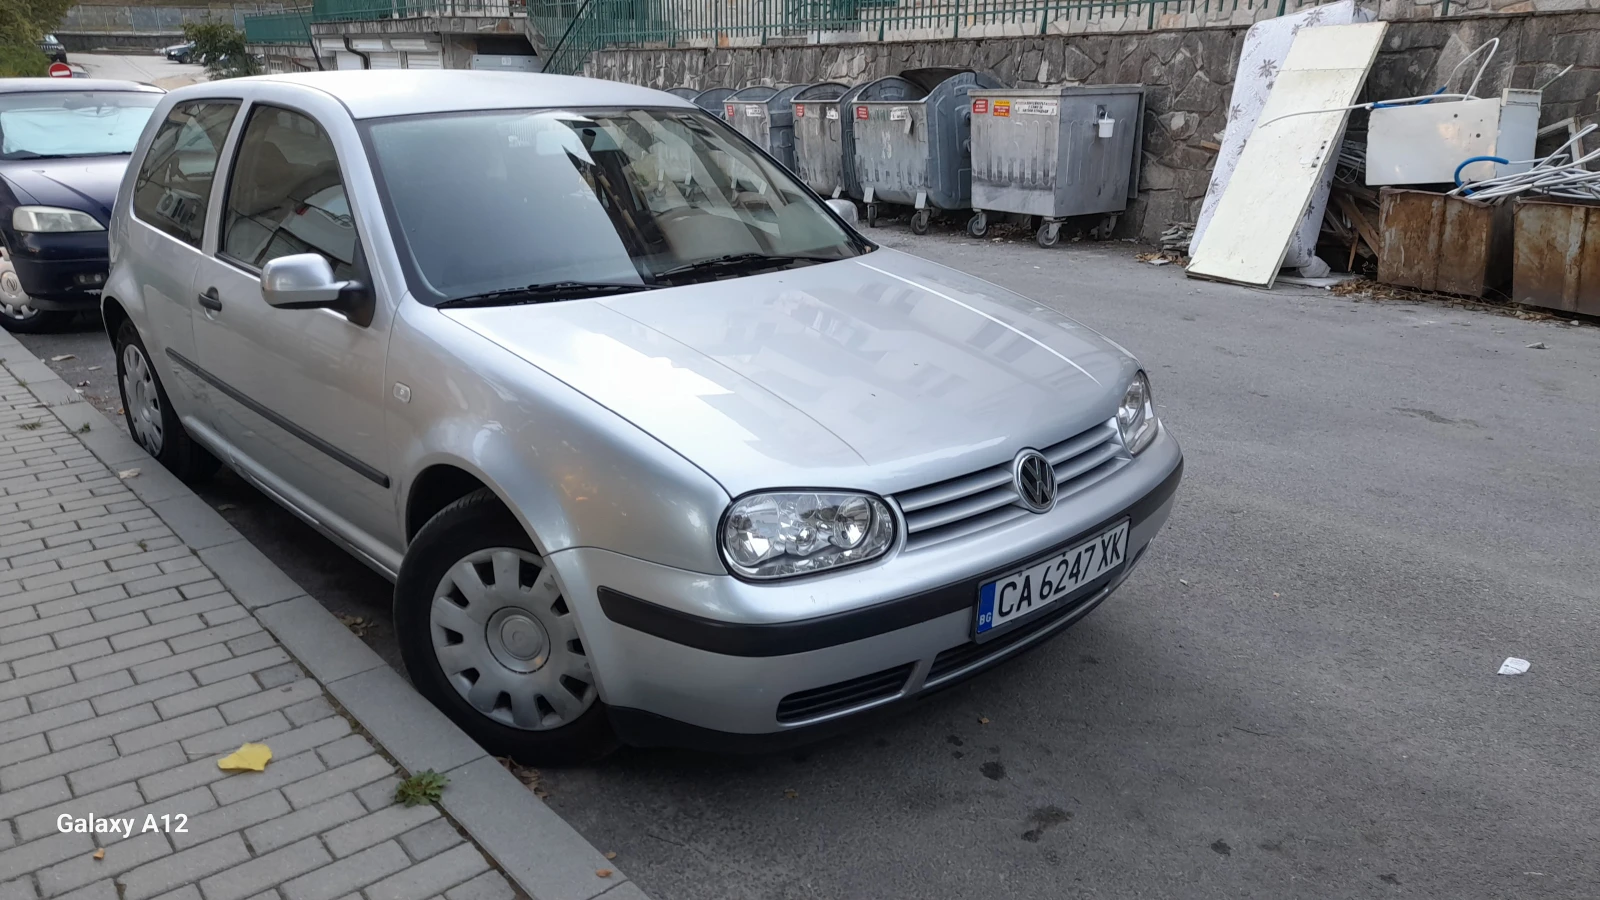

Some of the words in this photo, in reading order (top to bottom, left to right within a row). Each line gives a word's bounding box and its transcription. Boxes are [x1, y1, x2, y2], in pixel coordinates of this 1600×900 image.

[998, 574, 1032, 618] CA
[1039, 543, 1097, 601] 6247
[1097, 527, 1125, 572] XK
[979, 611, 992, 626] BG
